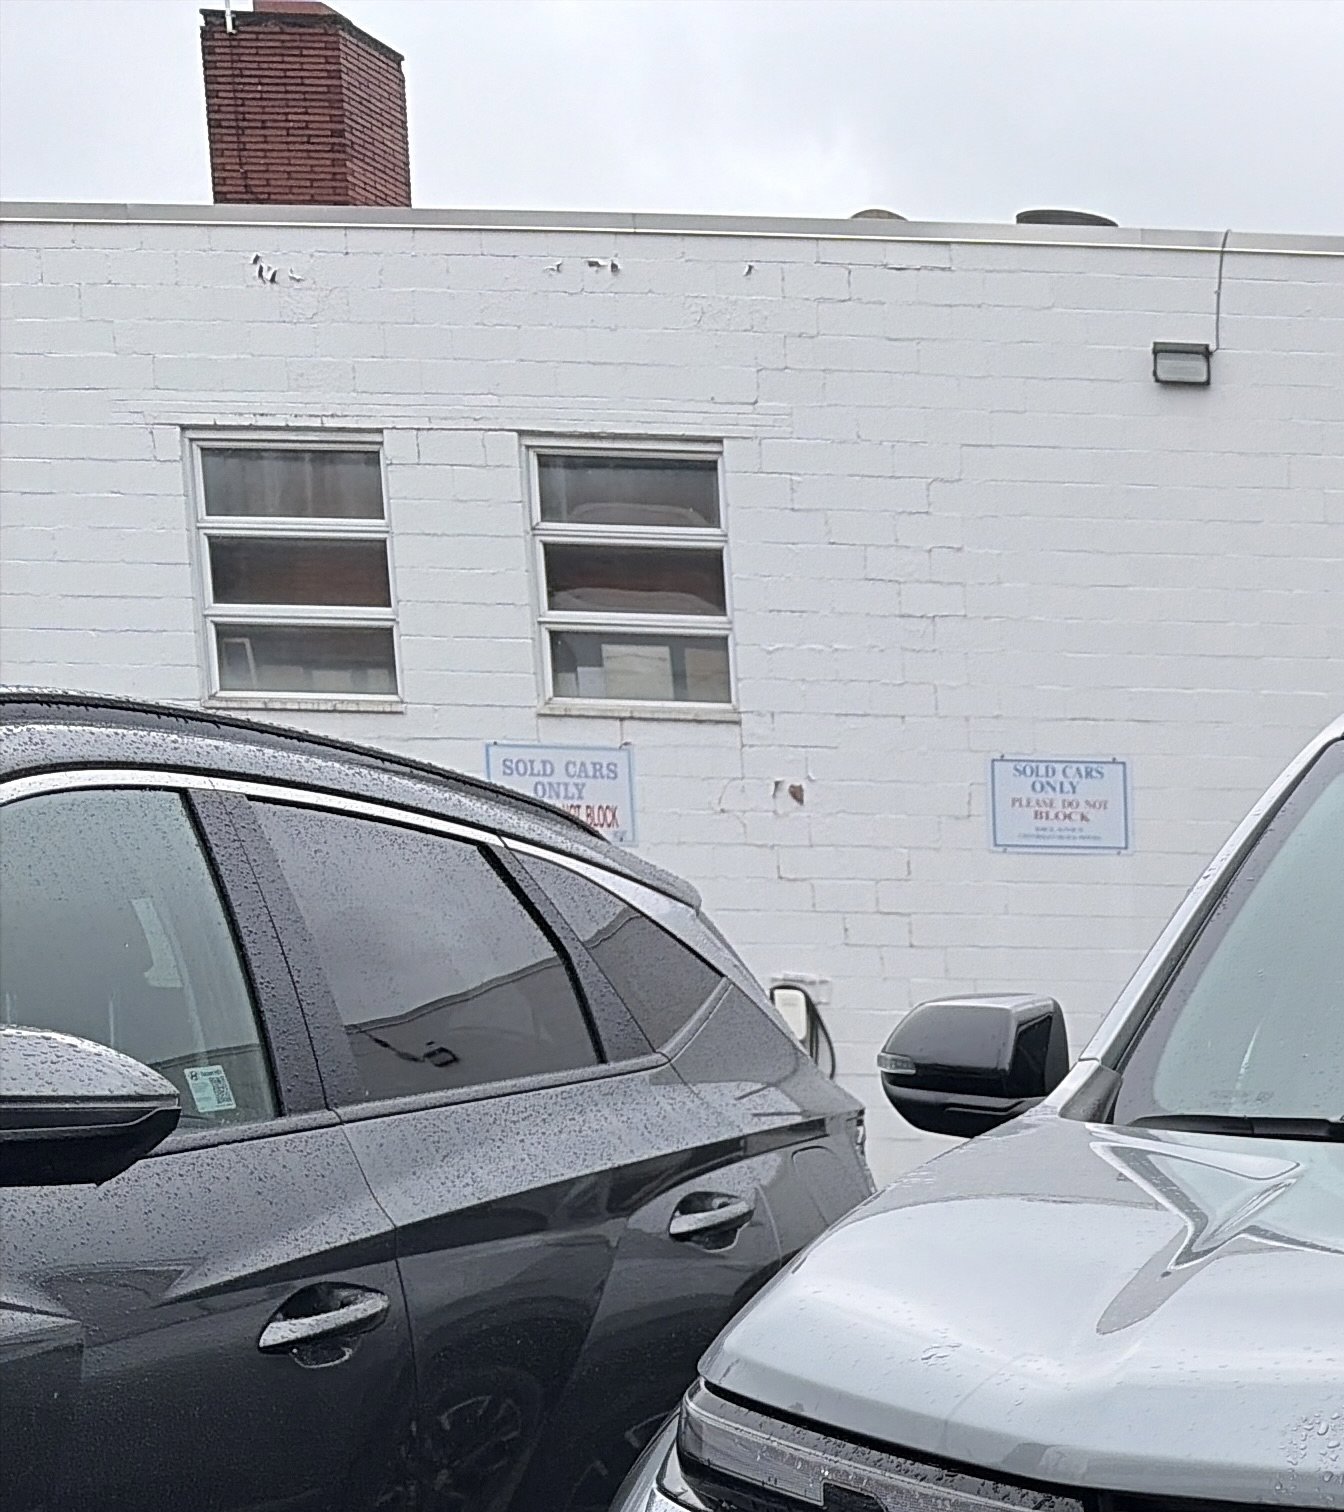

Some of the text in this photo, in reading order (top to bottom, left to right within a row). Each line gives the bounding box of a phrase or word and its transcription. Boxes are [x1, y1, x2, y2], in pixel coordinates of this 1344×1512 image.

[502, 758, 618, 780] SOLD CARS
[1012, 763, 1105, 780] SOLD CARS
[533, 781, 586, 801] ONLY
[1031, 780, 1079, 795] ONLY
[1010, 797, 1109, 811] PLEASE DO NOT
[586, 804, 619, 828] BLOCK
[1033, 810, 1090, 822] BLOCK
